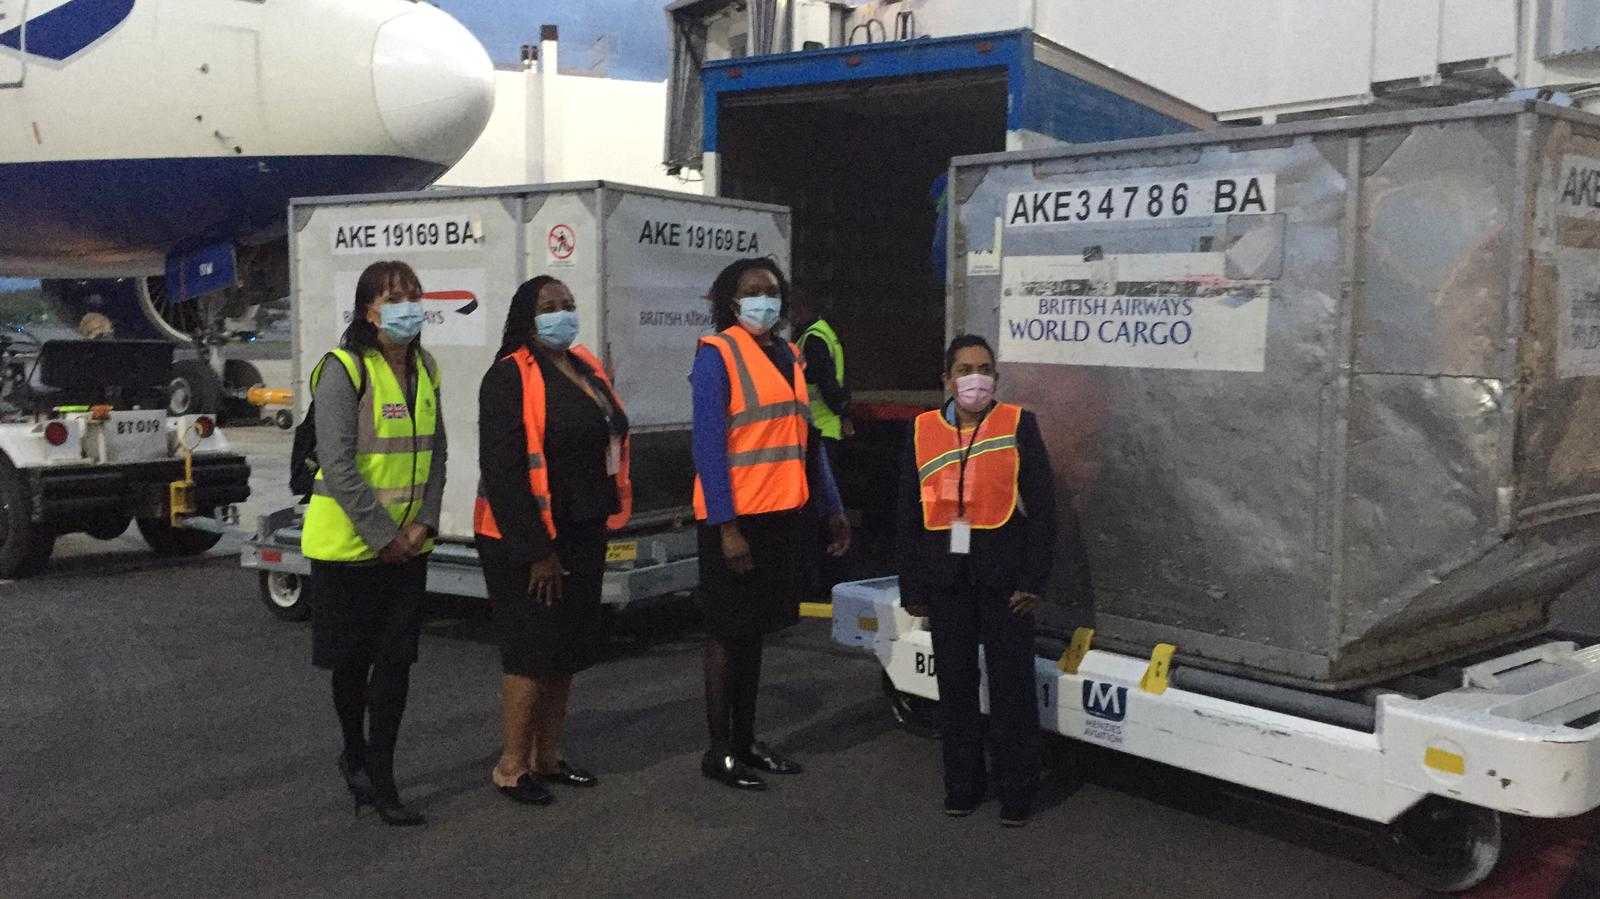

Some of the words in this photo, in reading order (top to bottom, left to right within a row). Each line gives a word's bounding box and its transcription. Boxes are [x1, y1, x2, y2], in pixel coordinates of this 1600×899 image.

[1010, 182, 1189, 224] AKE34786
[1214, 177, 1267, 214] BA
[335, 225, 376, 249] AKE
[382, 222, 439, 247] 19169
[446, 220, 479, 244] BA
[638, 220, 682, 246] AKE
[686, 225, 734, 250] 19169
[735, 230, 760, 253] EA
[640, 311, 682, 326] BRITISH
[1039, 298, 1106, 315] BRITISH
[1111, 298, 1193, 317] AIRWAYS
[1008, 318, 1090, 342] WORLD
[1098, 319, 1192, 346] CARGO
[117, 419, 160, 435] BT019
